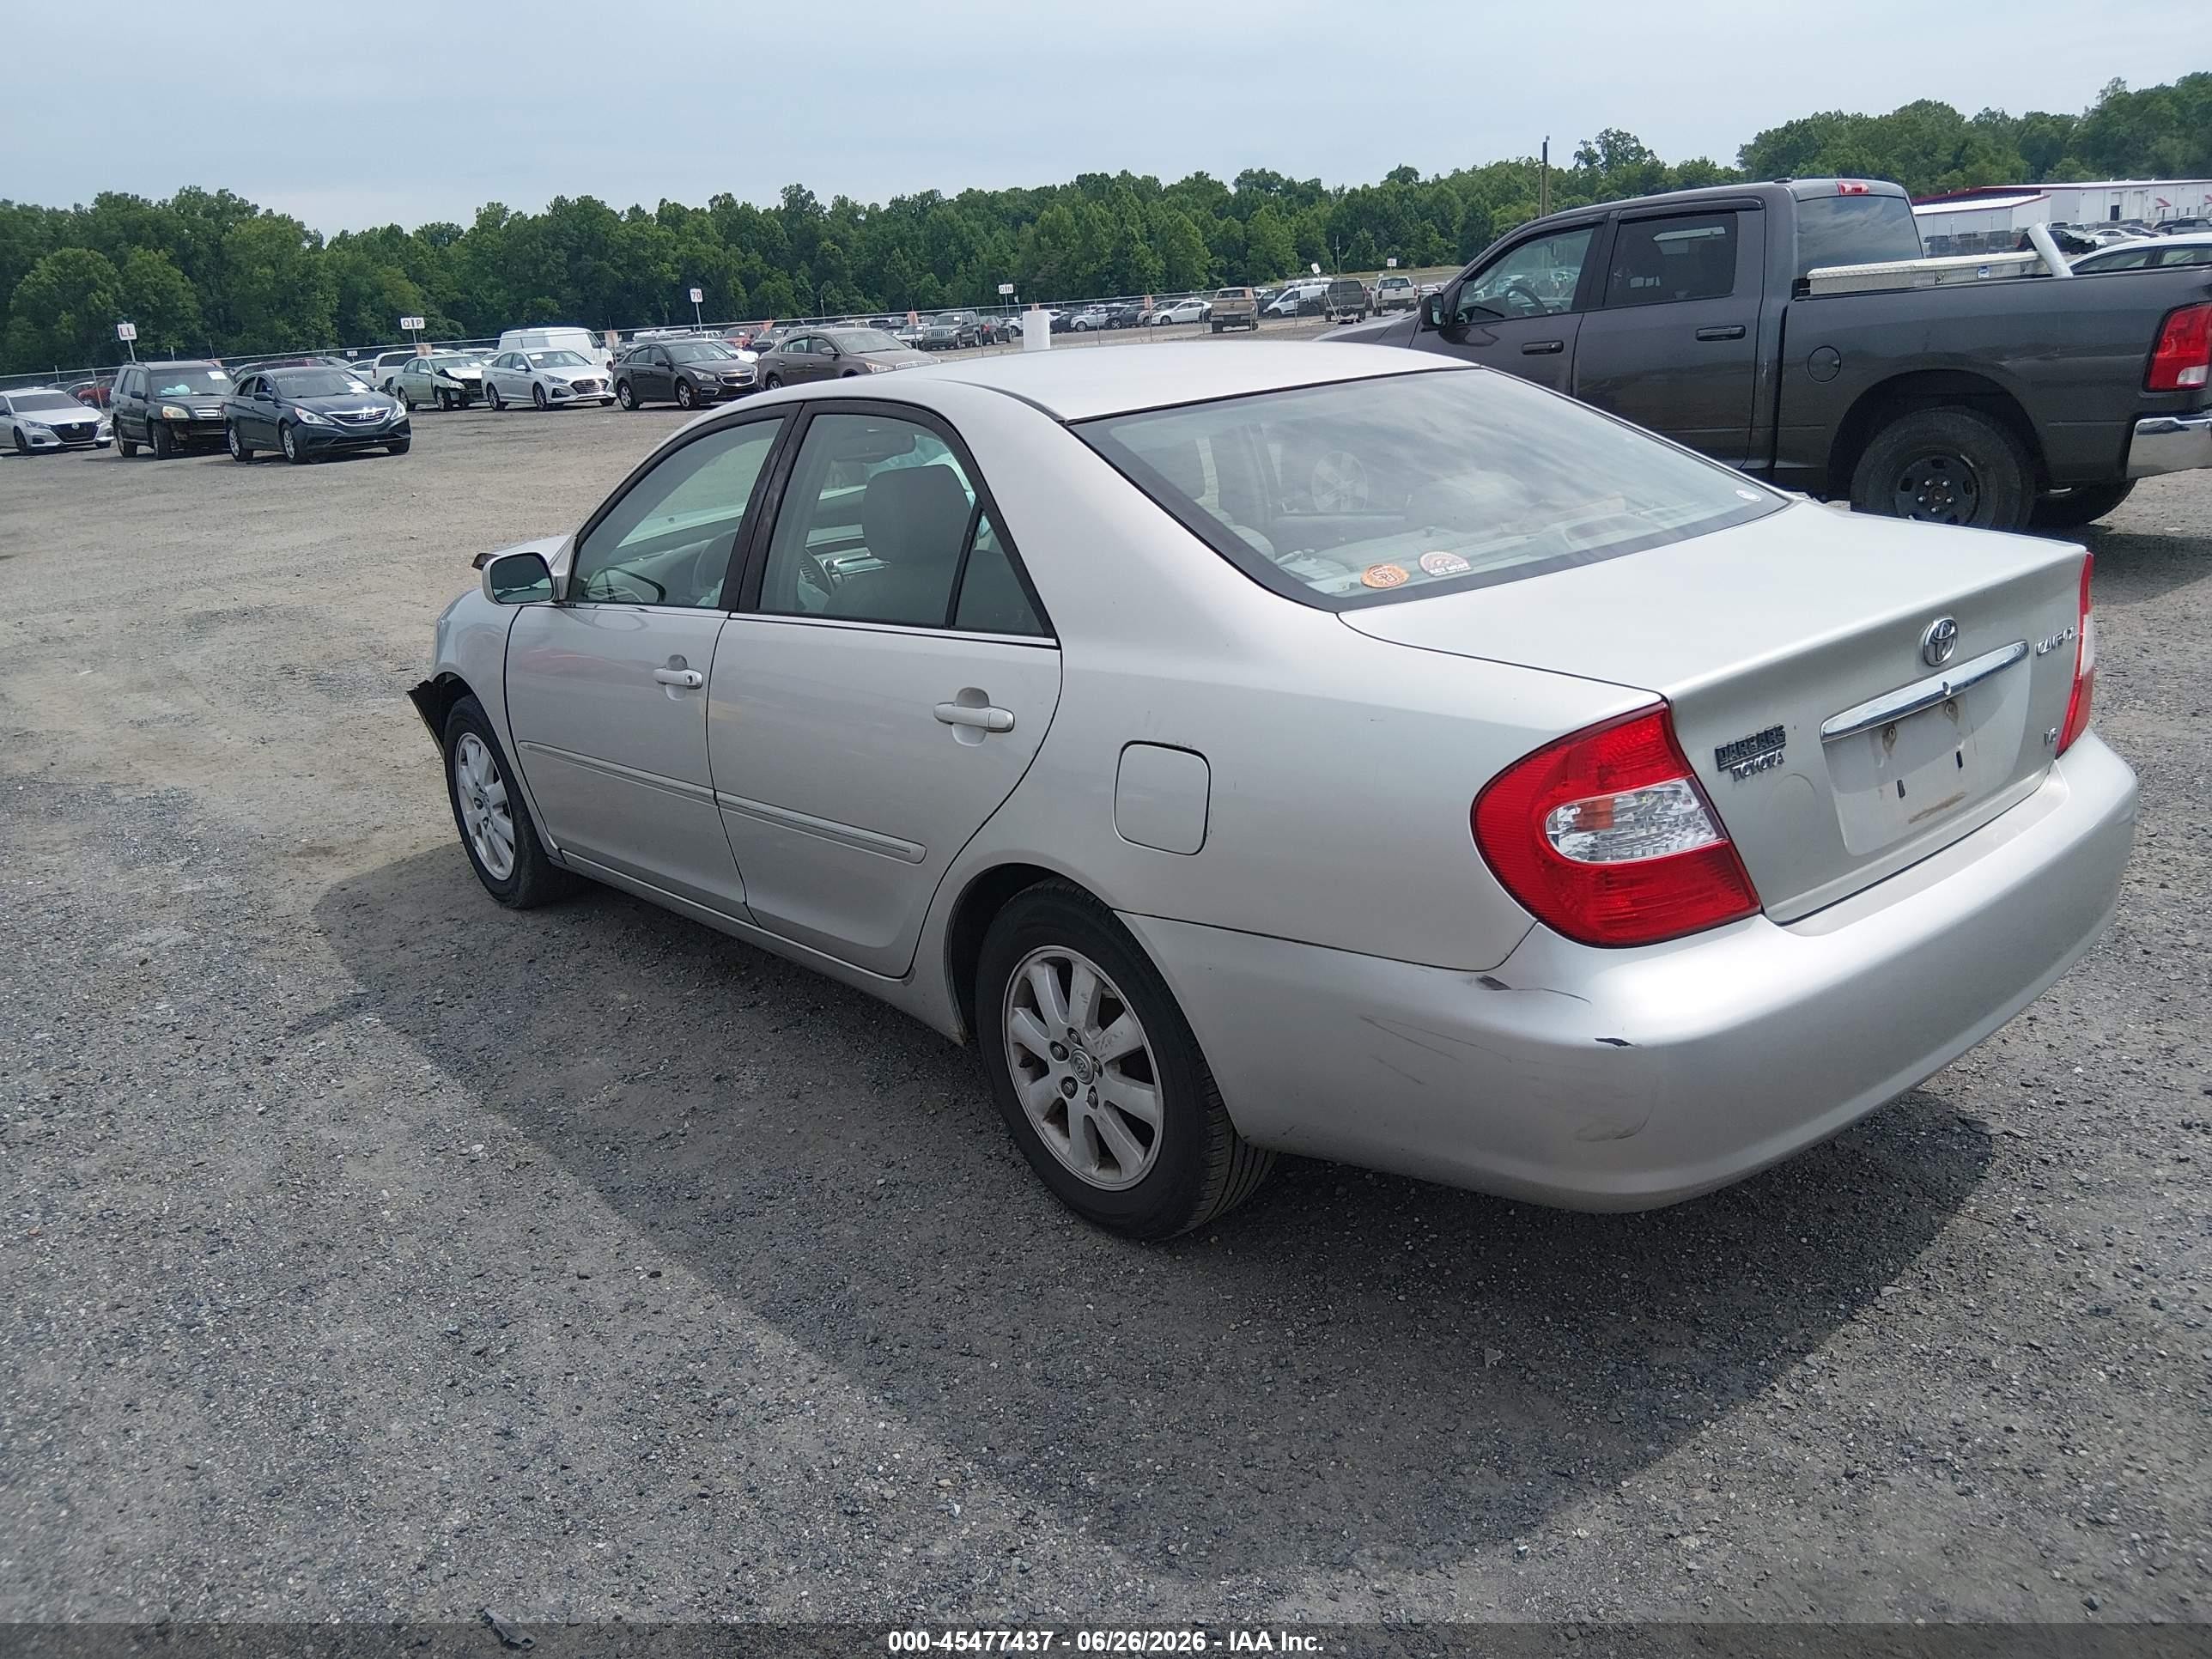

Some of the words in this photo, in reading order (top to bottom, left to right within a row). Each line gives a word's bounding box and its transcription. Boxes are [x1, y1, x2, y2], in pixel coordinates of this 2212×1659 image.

[691, 291, 702, 300] 70
[119, 327, 135, 337] LL
[1729, 750, 1785, 781] TOYOTA
